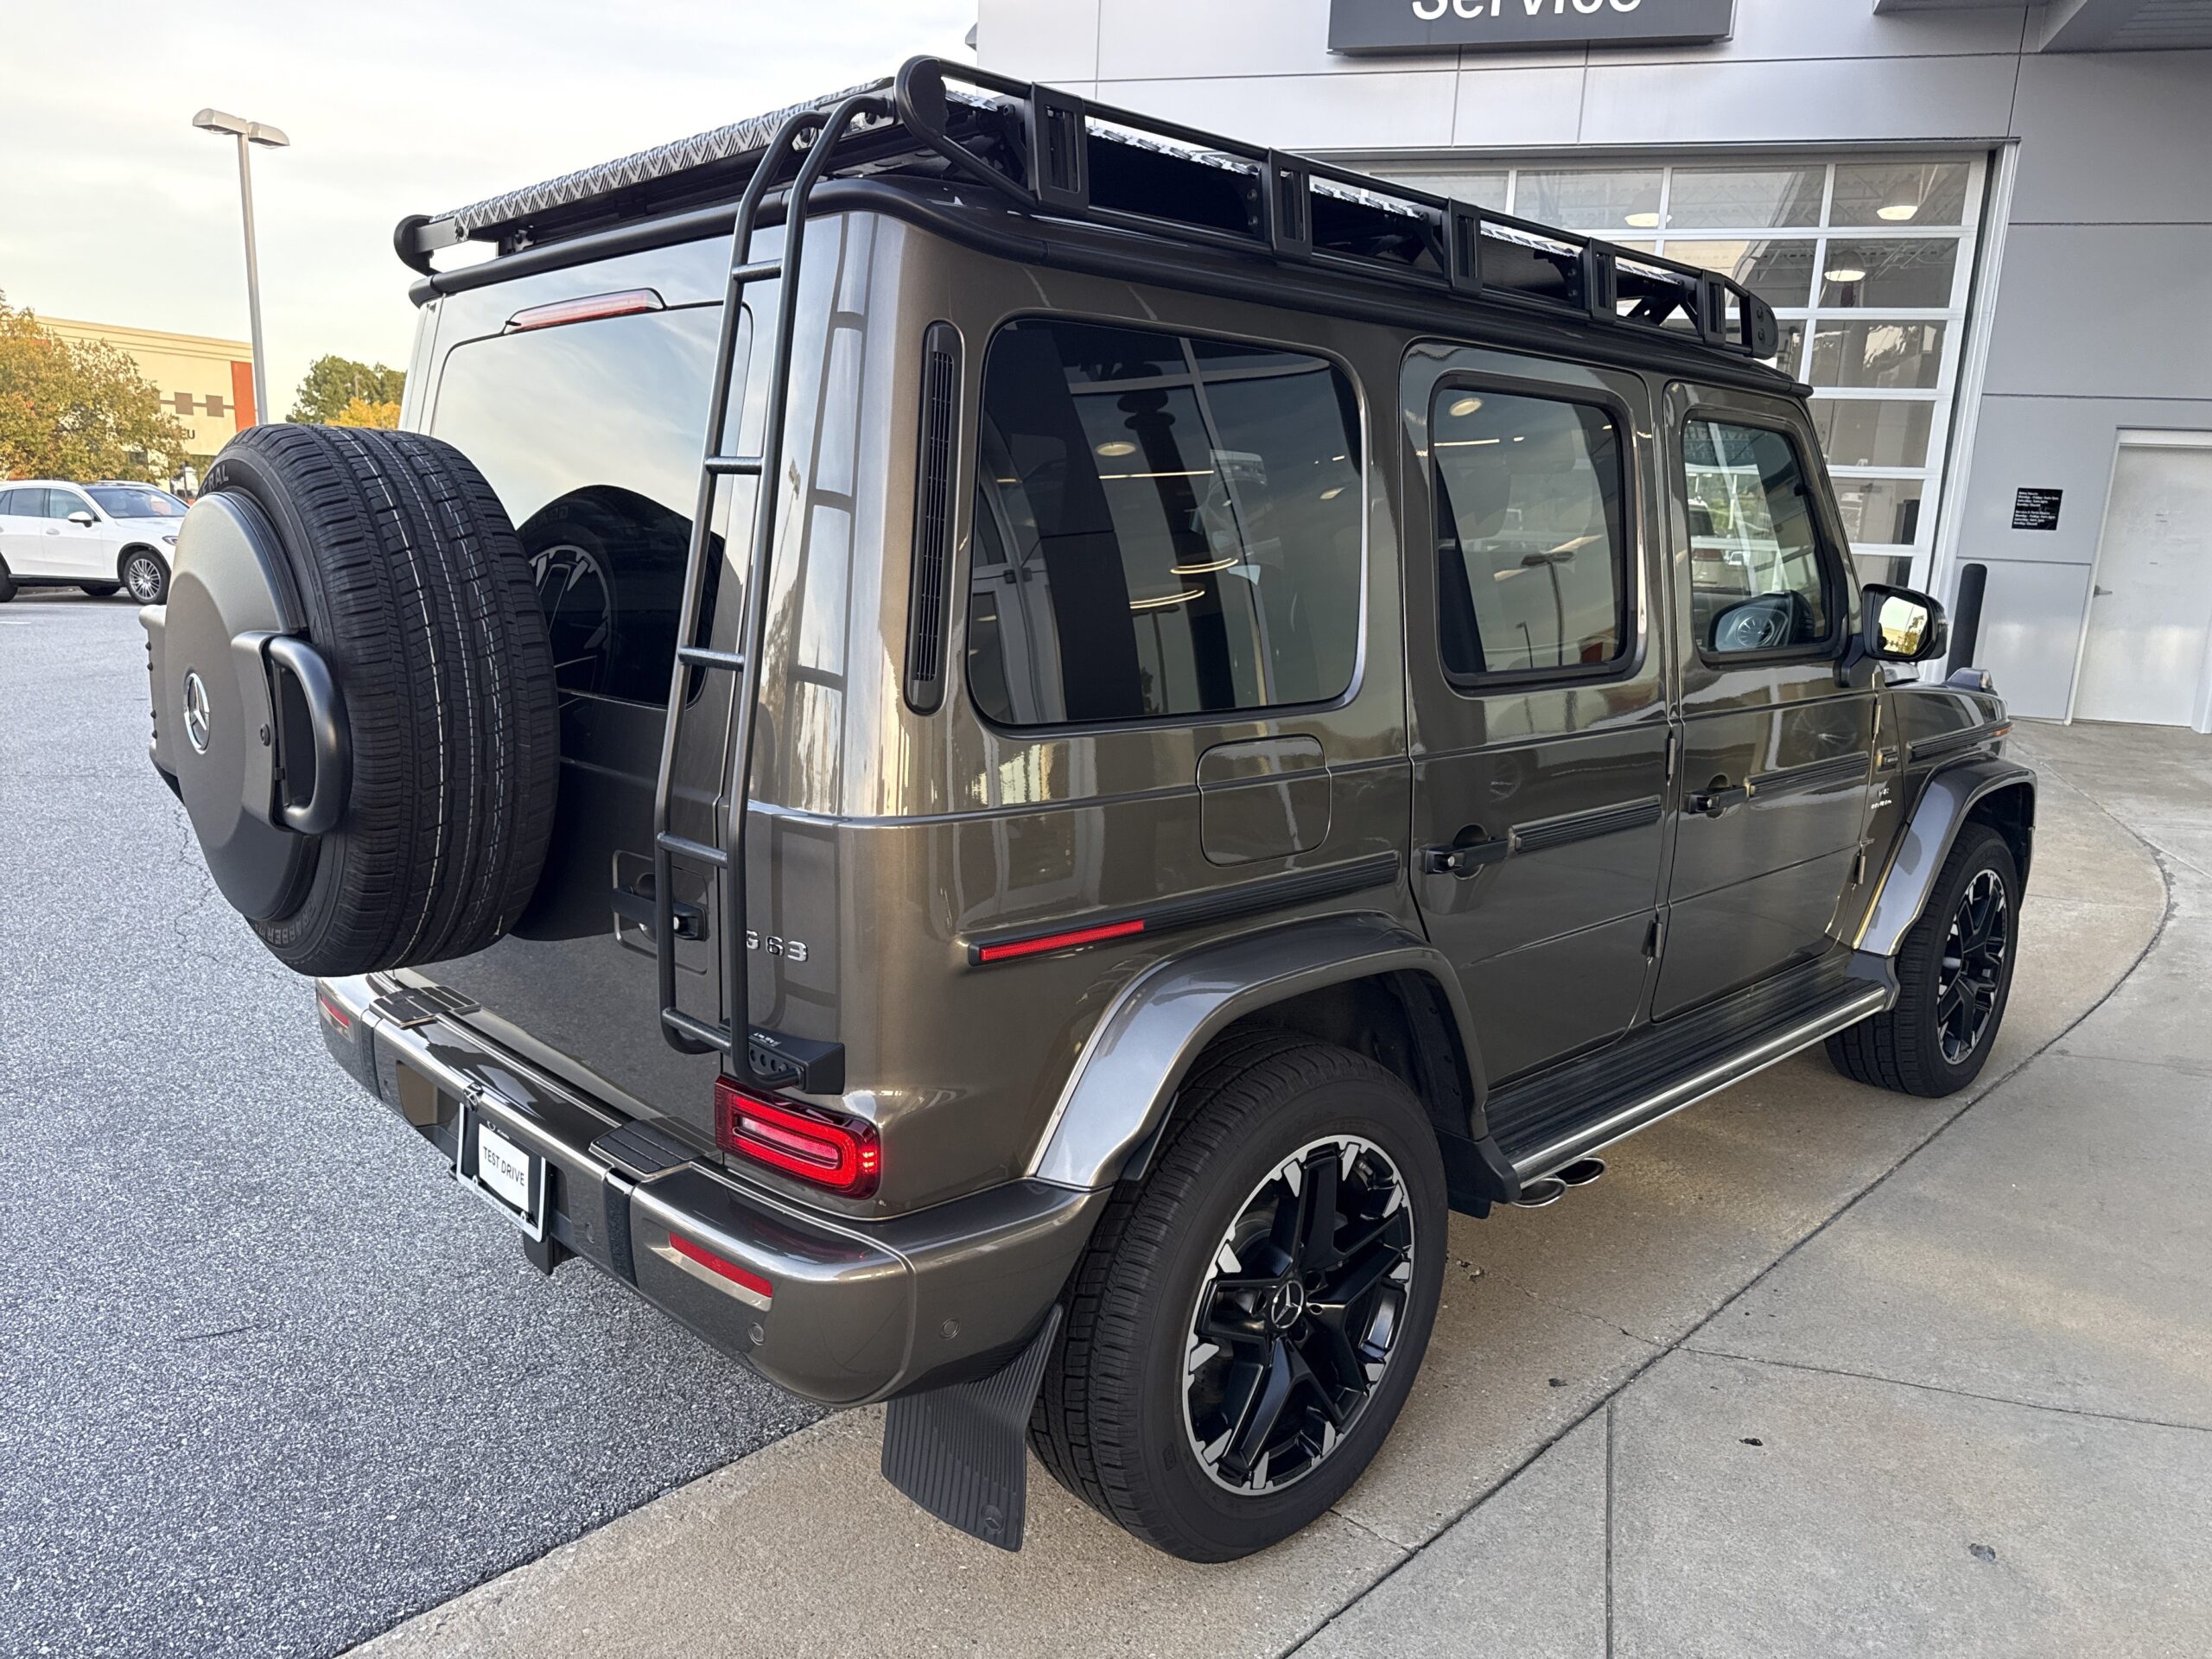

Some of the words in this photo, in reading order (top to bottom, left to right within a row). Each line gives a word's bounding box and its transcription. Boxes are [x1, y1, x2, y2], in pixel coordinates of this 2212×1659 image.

[766, 936, 809, 962] 63
[483, 1147, 499, 1168] TEST
[501, 1160, 524, 1186] DRIVE
